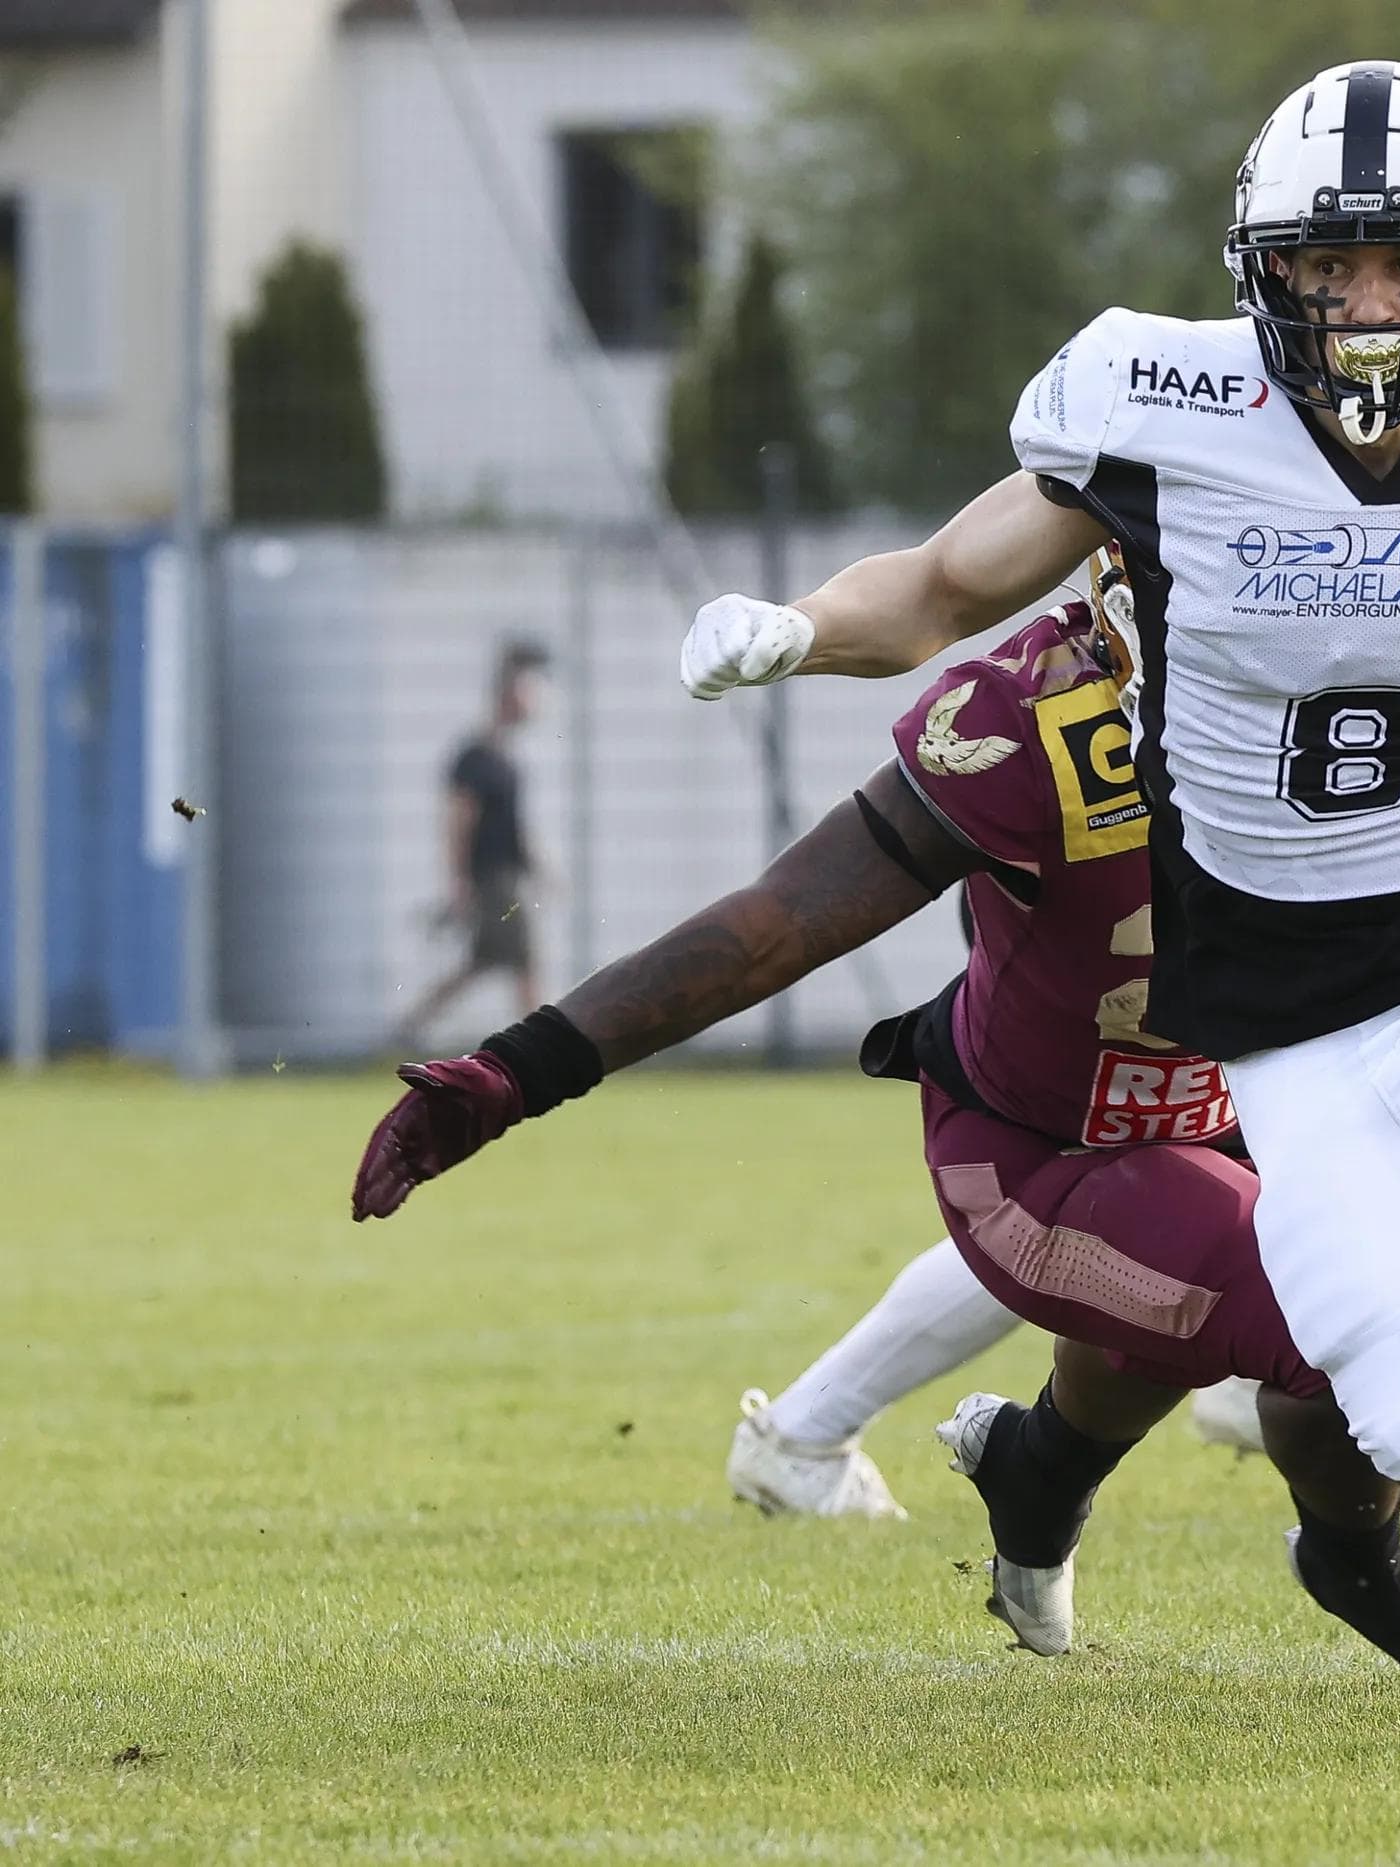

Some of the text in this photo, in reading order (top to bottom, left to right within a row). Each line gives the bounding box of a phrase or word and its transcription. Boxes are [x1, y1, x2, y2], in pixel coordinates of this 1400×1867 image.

[1342, 196, 1382, 208] schutt
[1131, 358, 1245, 403] HAAF
[1128, 393, 1245, 418] Logistik & Transport
[1106, 1062, 1228, 1106] RE
